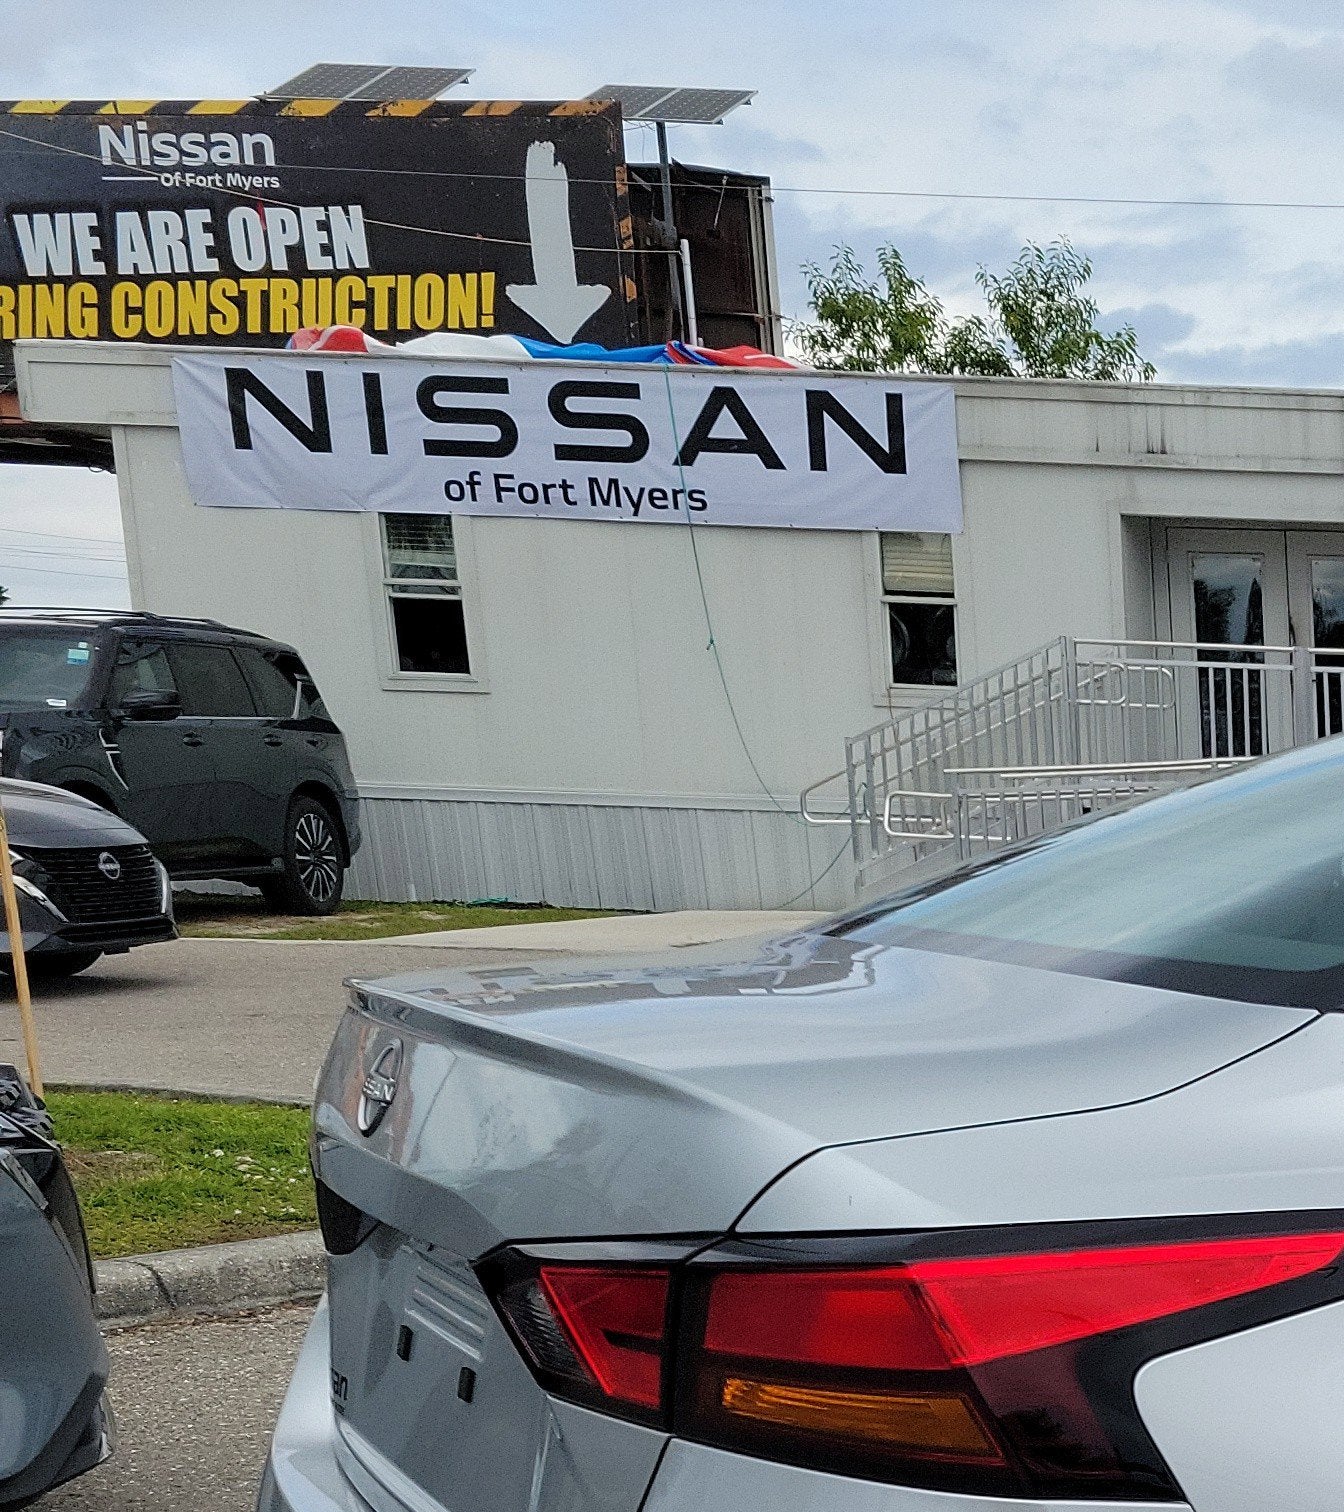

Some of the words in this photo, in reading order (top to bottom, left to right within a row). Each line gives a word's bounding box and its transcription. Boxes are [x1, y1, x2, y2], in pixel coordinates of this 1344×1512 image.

[98, 121, 277, 167] Nissan
[160, 172, 182, 188] Of
[185, 172, 224, 188] Fort
[226, 172, 281, 191] Myers
[12, 212, 107, 277] WE
[115, 208, 220, 276] ARE
[227, 204, 371, 273] OPEN
[110, 271, 496, 339] CONSTRUCTION!
[223, 366, 909, 475] NISSAN
[443, 470, 482, 503] of
[491, 472, 576, 508] Fort
[587, 476, 708, 517] Myers
